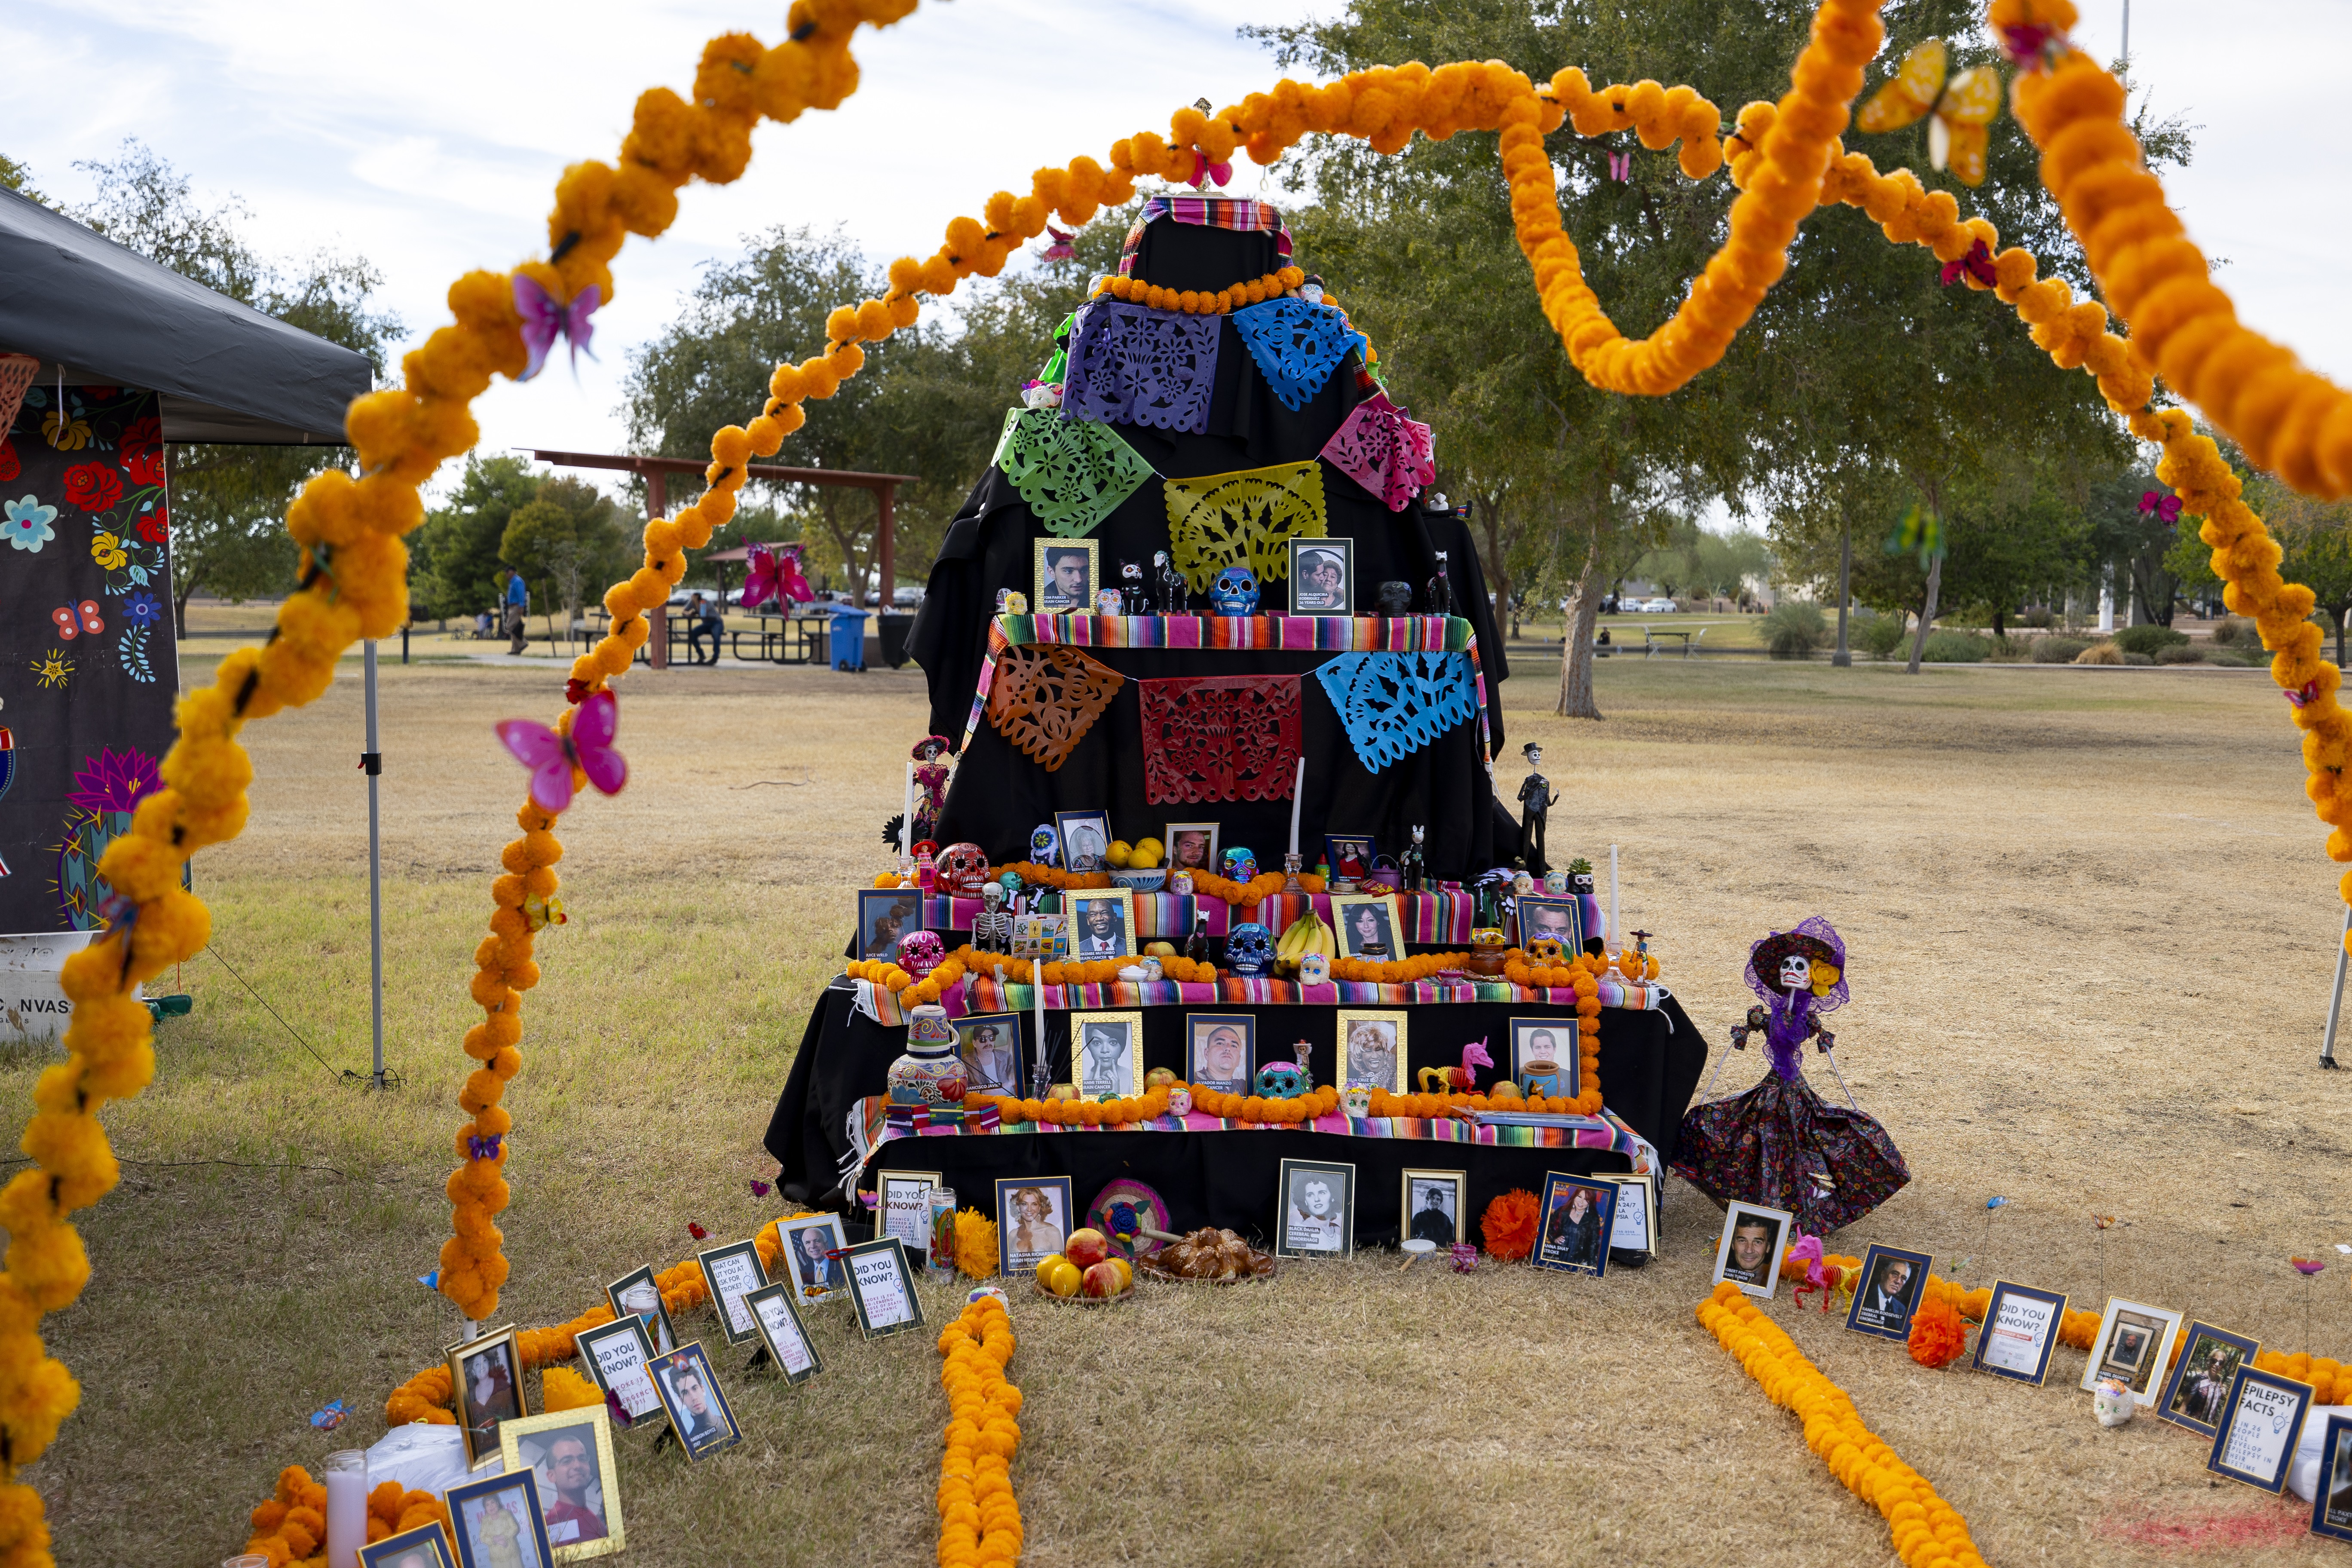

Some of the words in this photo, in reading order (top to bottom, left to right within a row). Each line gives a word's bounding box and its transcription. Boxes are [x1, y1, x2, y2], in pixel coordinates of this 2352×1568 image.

[887, 1190, 902, 1198] DID
[905, 1191, 925, 1200] YOU
[887, 1201, 923, 1211] KNOW?
[727, 1258, 740, 1267] CAN
[854, 1265, 869, 1275] DID
[870, 1260, 891, 1271] YOU
[724, 1268, 736, 1276] YOU
[729, 1275, 741, 1283] FOR
[720, 1282, 742, 1293] TROKE?
[865, 1298, 894, 1307] RD-LEADING
[769, 1305, 784, 1317] YOU
[1880, 1311, 1902, 1319] ROOSEVELT
[2000, 1303, 2018, 1314] DID
[2022, 1307, 2046, 1320] YOU
[1859, 1316, 1884, 1324] EMORRHAGE
[1997, 1314, 2040, 1331] KNOW?
[612, 1342, 634, 1357] YOU
[616, 1379, 635, 1391] ROKE
[622, 1387, 653, 1404] ERGENCY
[2243, 1384, 2295, 1407] EPILEPSY
[2239, 1397, 2275, 1417] FACTS
[690, 1432, 705, 1442] AMERON
[704, 1426, 717, 1436] BOYCE
[2231, 1432, 2248, 1442] WILL
[2233, 1425, 2260, 1439] PEOPLE
[2229, 1438, 2262, 1452] DEVELOP
[2226, 1451, 2246, 1462] THEIR
[2227, 1445, 2262, 1460] EPILEPSY
[2223, 1458, 2255, 1472] LIFETIME
[2328, 1514, 2346, 1523] TROKE
